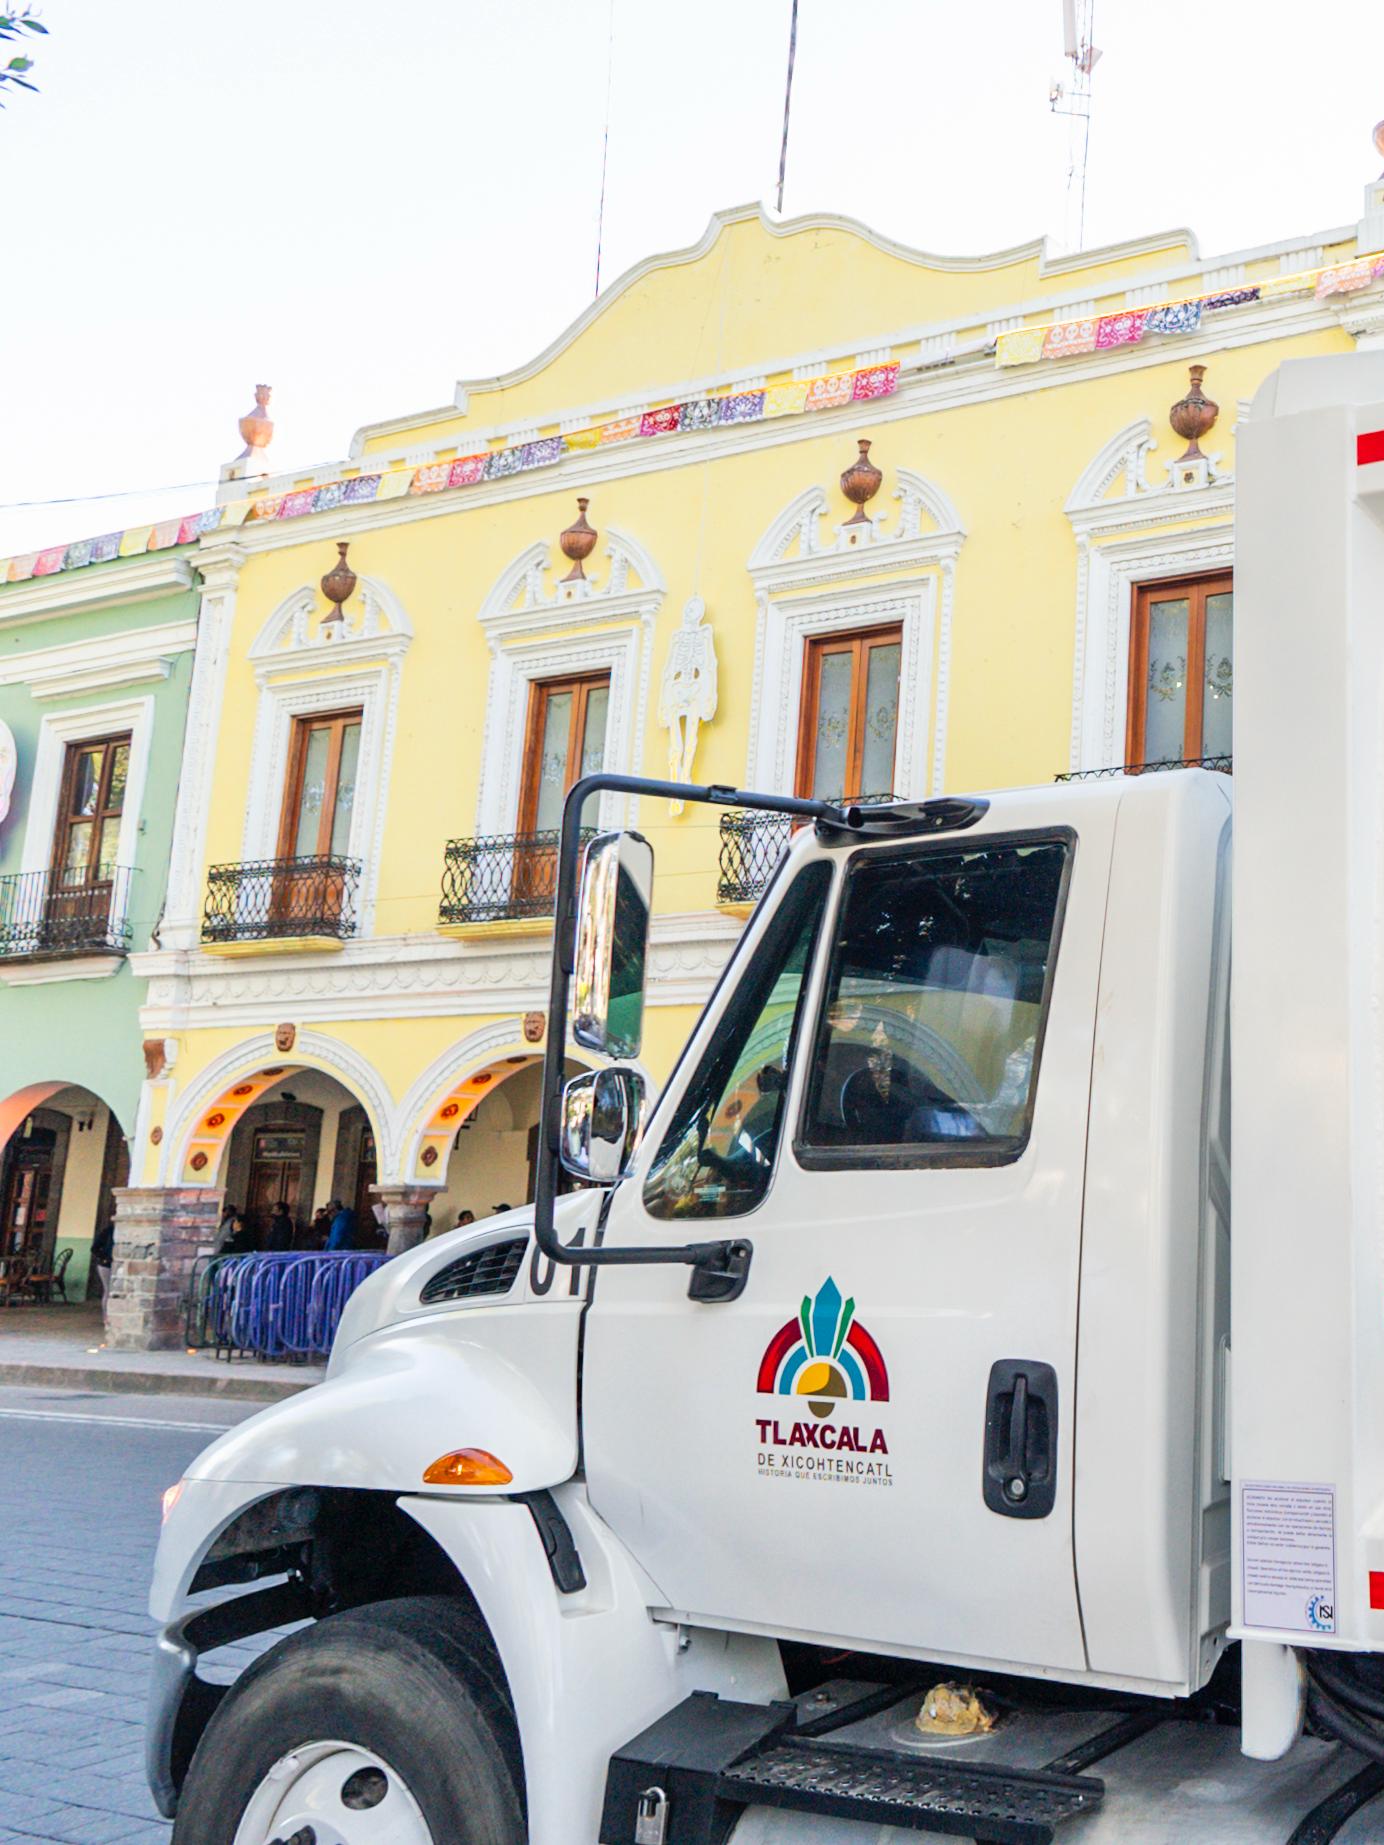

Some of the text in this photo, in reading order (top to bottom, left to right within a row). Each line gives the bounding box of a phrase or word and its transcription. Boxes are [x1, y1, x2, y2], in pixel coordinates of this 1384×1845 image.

[755, 1419, 889, 1455] TLAXCALA
[757, 1453, 893, 1477] DE XICOHTENCATL
[758, 1469, 893, 1486] HISTORIA QUE ESCRIBIMOS JUNTOS
